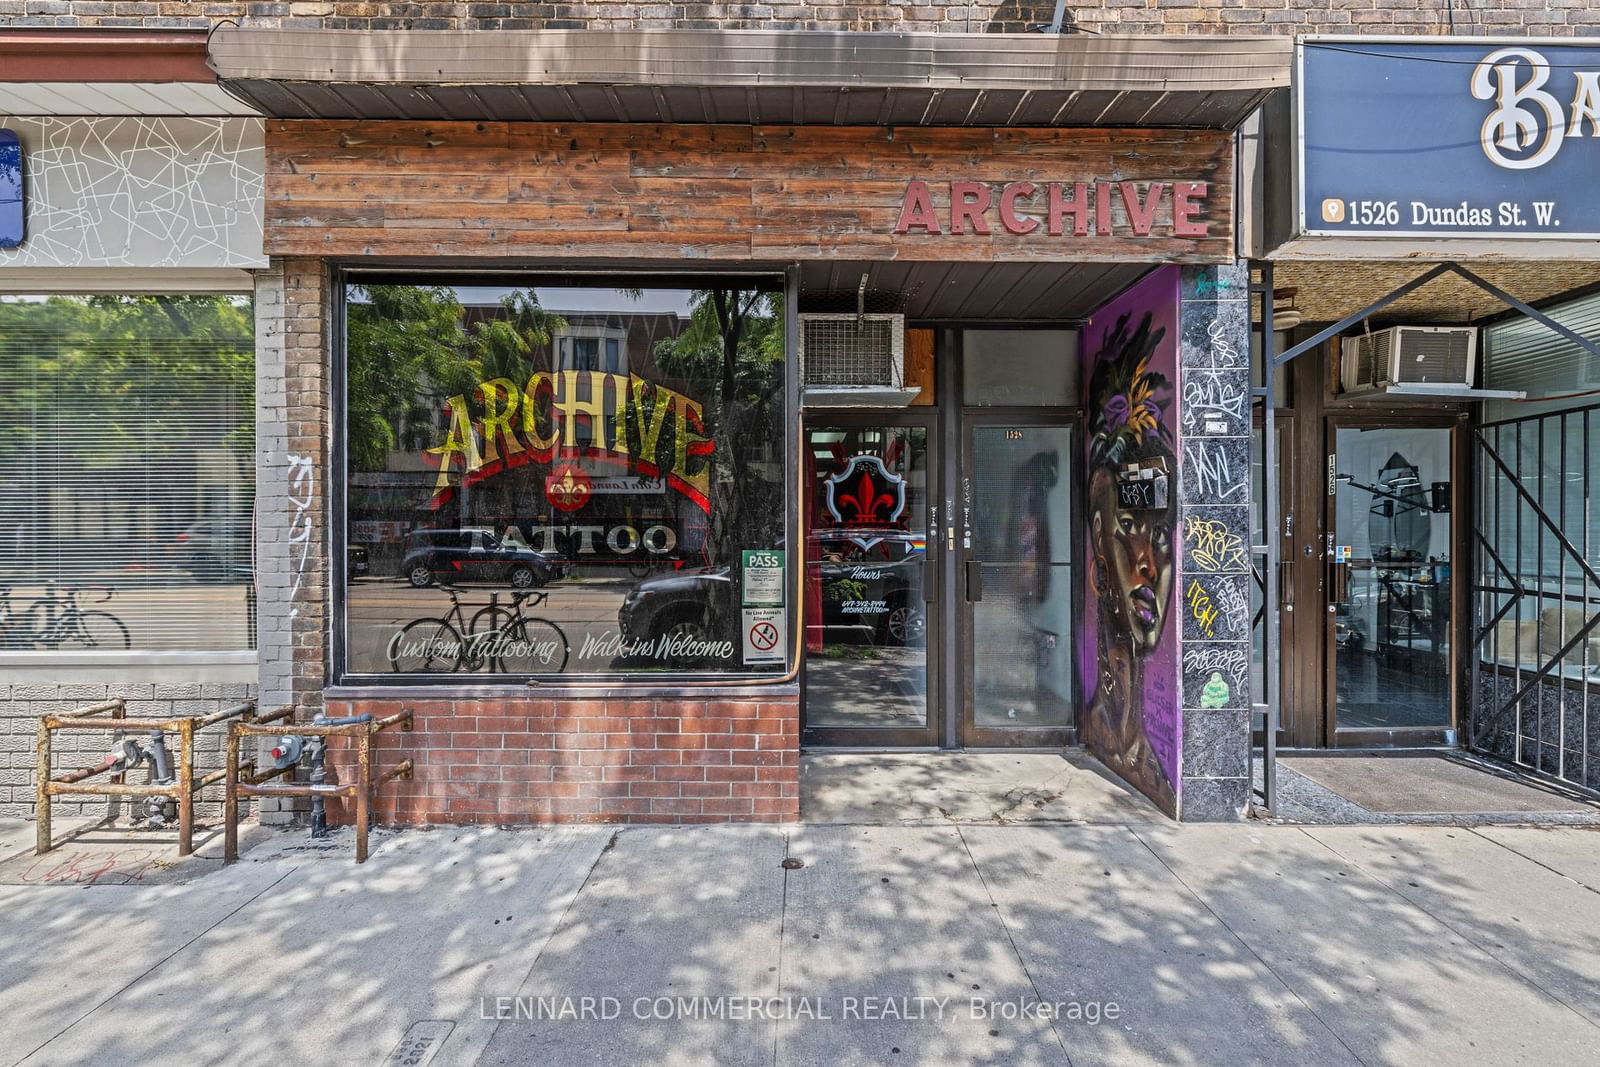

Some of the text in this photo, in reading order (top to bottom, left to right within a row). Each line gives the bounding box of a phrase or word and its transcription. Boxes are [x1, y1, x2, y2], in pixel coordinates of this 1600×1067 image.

[893, 181, 1208, 237] ARCHIVE
[1349, 201, 1560, 226] 1526 Dundas St. W.
[423, 369, 715, 508] ARCHIVE
[460, 524, 677, 554] TATTOO
[749, 555, 779, 567] PASS
[851, 566, 880, 580] Hours
[386, 630, 460, 661] Custom
[461, 630, 558, 664] Tattooing
[655, 631, 734, 660] Welcome
